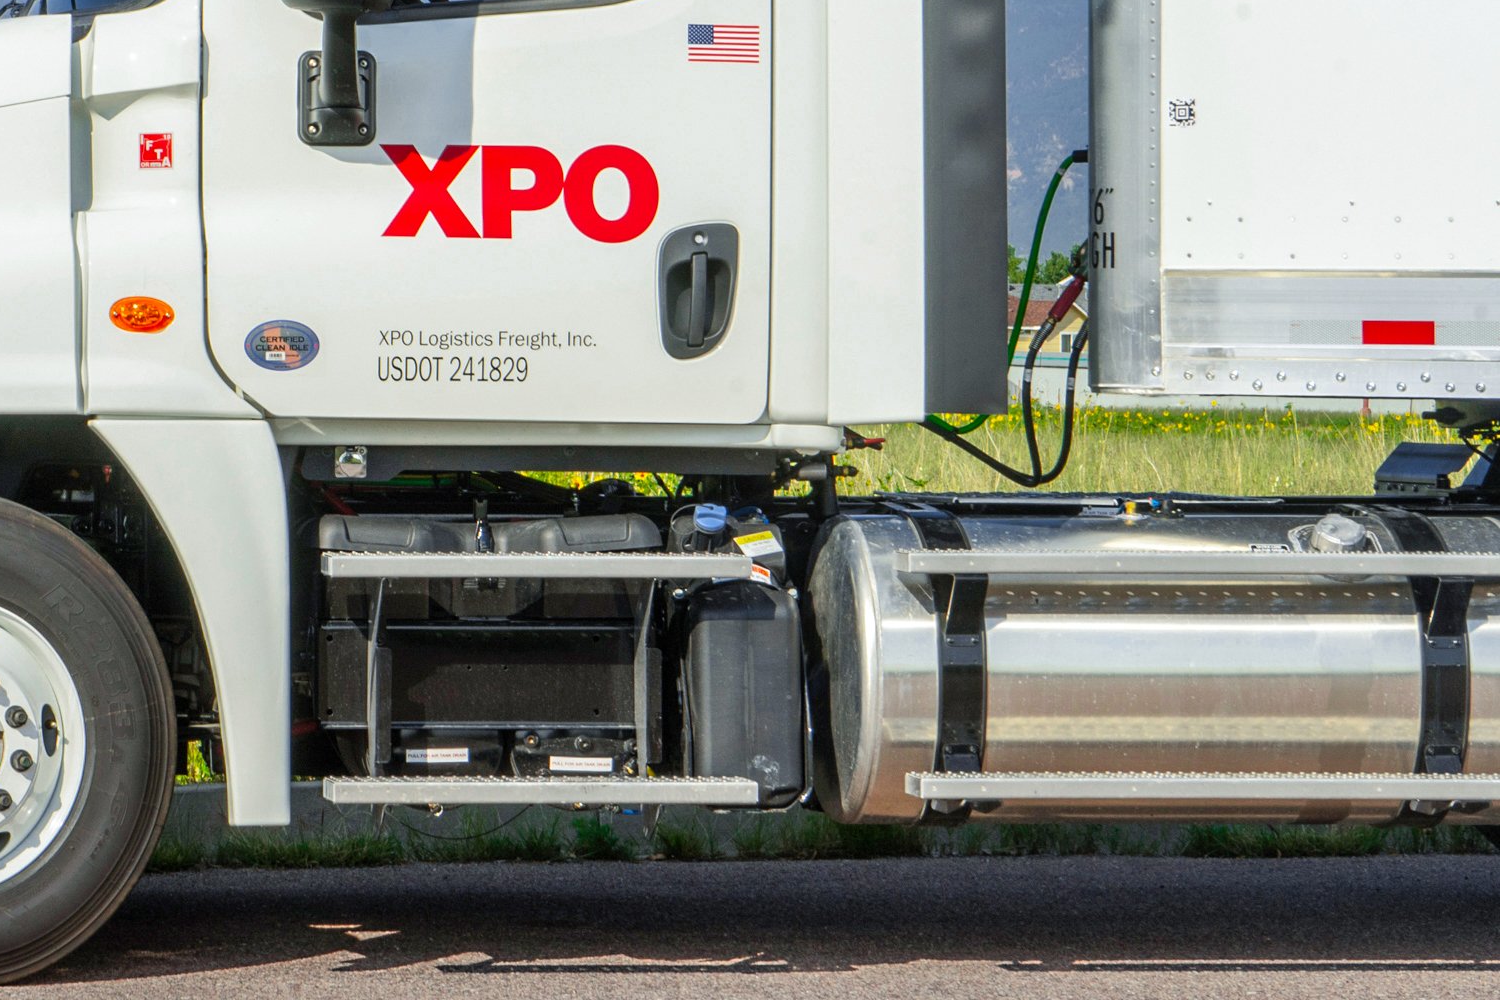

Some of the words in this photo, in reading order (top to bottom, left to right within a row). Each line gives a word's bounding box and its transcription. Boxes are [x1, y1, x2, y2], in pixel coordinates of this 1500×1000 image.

[378, 143, 660, 244] XPO
[255, 344, 286, 352] CLEAN
[260, 335, 305, 343] CERTIFIED
[378, 330, 414, 346] XPO
[419, 330, 493, 350] Logistics
[498, 330, 562, 350] Freight,
[567, 331, 597, 347] Inc.
[378, 356, 444, 382] USDOT
[449, 356, 529, 382] 241829
